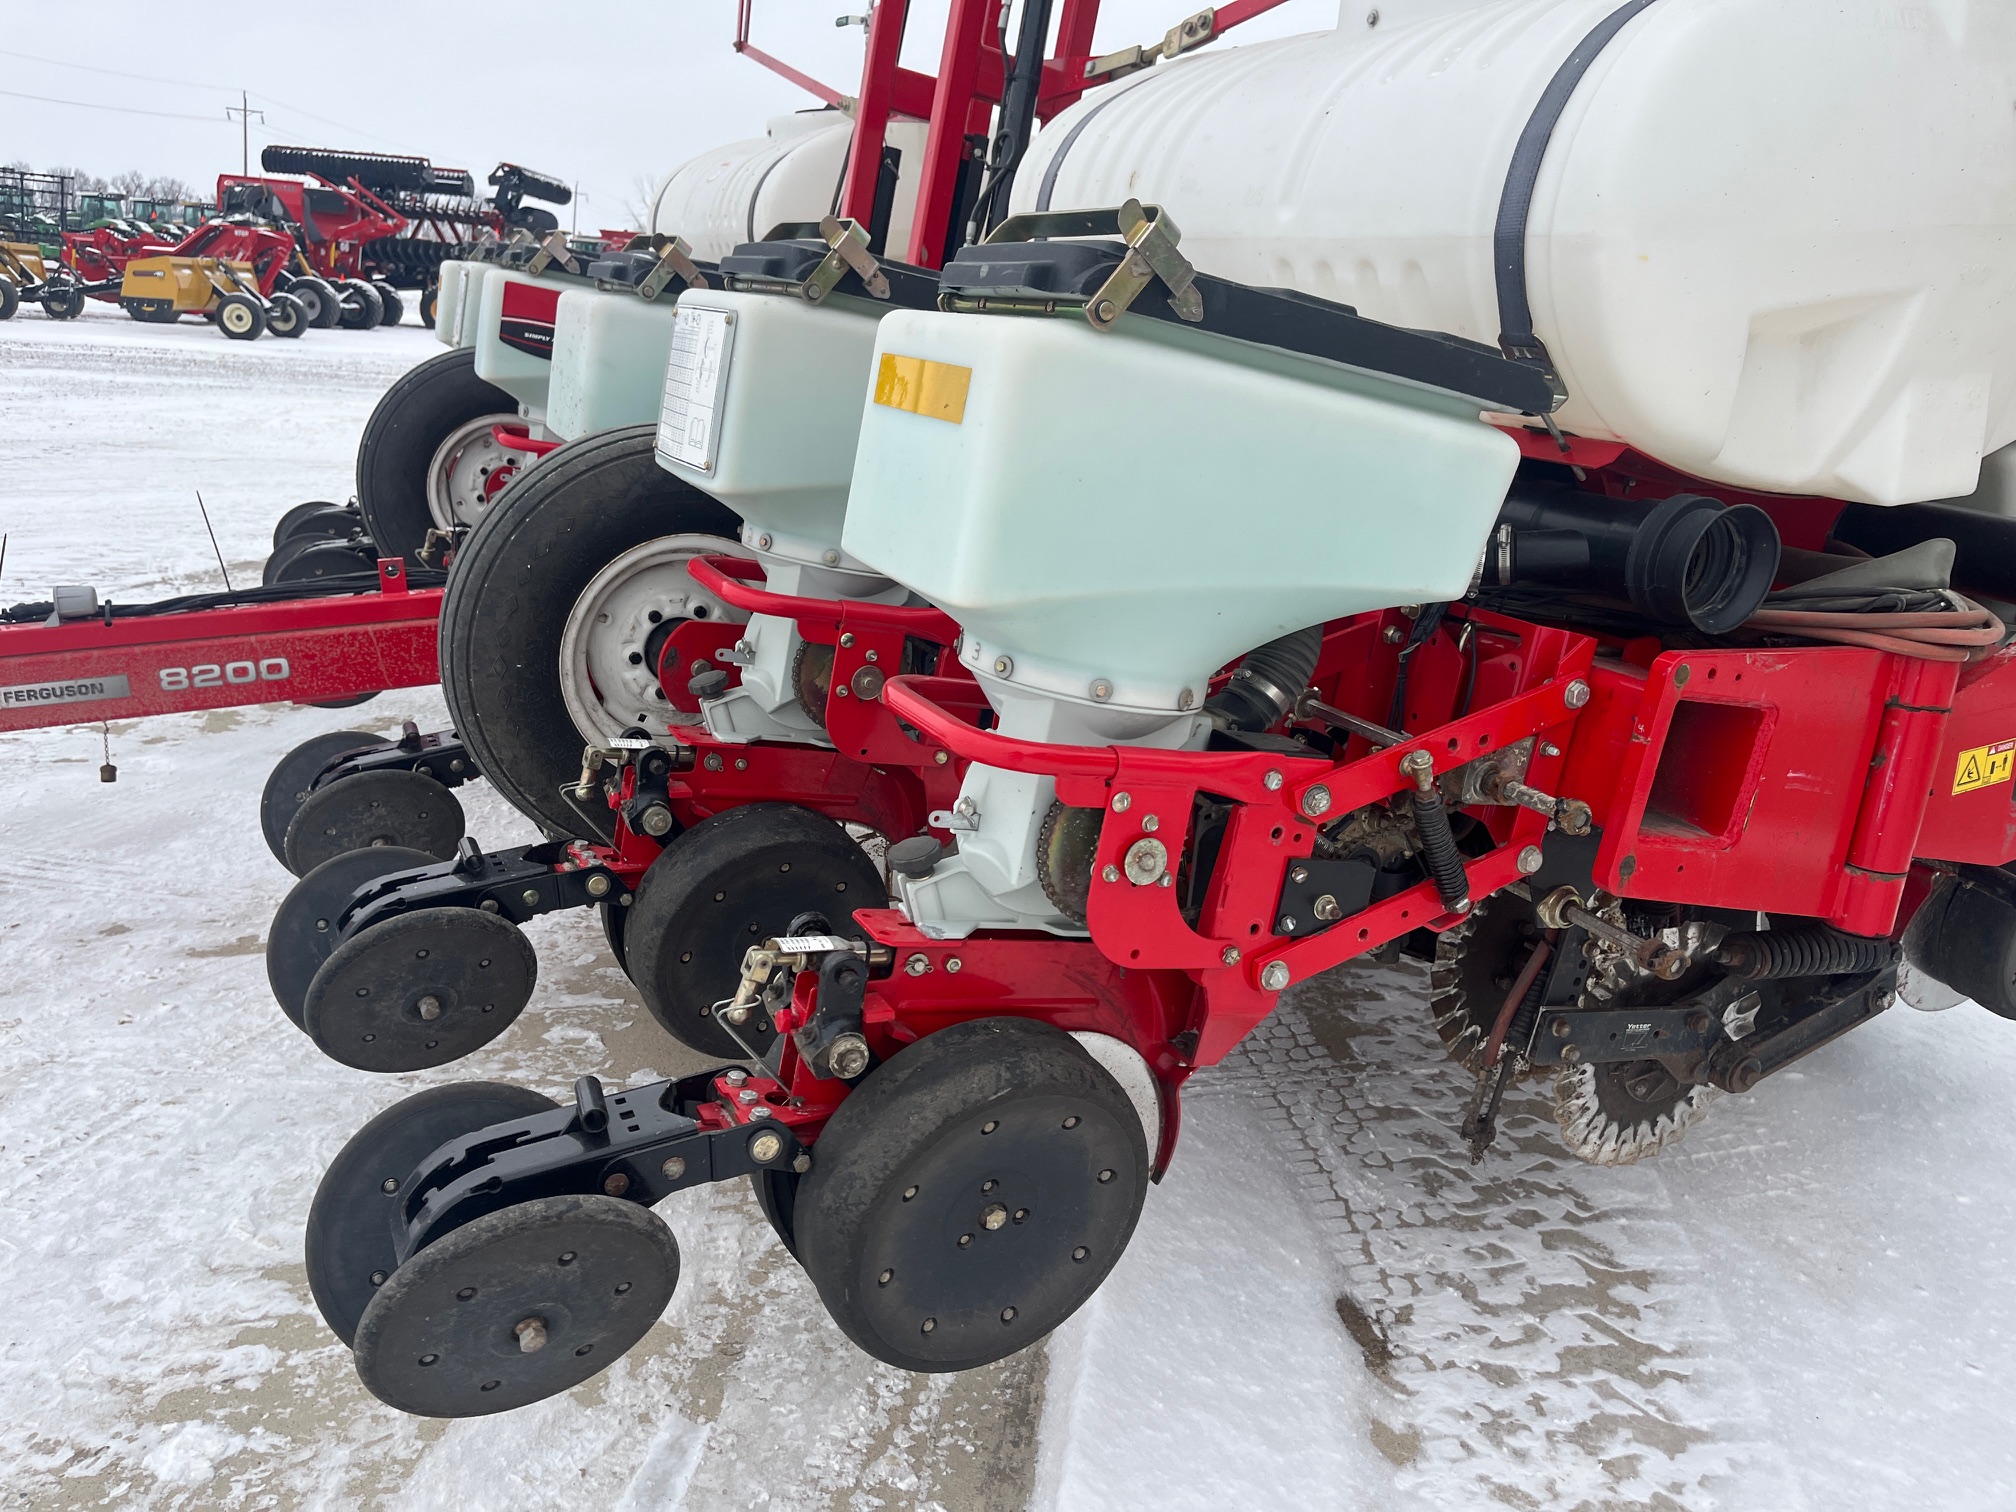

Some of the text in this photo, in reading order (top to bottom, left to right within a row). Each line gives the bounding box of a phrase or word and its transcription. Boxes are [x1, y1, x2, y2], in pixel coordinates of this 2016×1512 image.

[524, 332, 551, 342] SIMPLY
[971, 641, 982, 661] 3
[158, 657, 291, 691] 8200
[2, 682, 105, 704] FERGUSON
